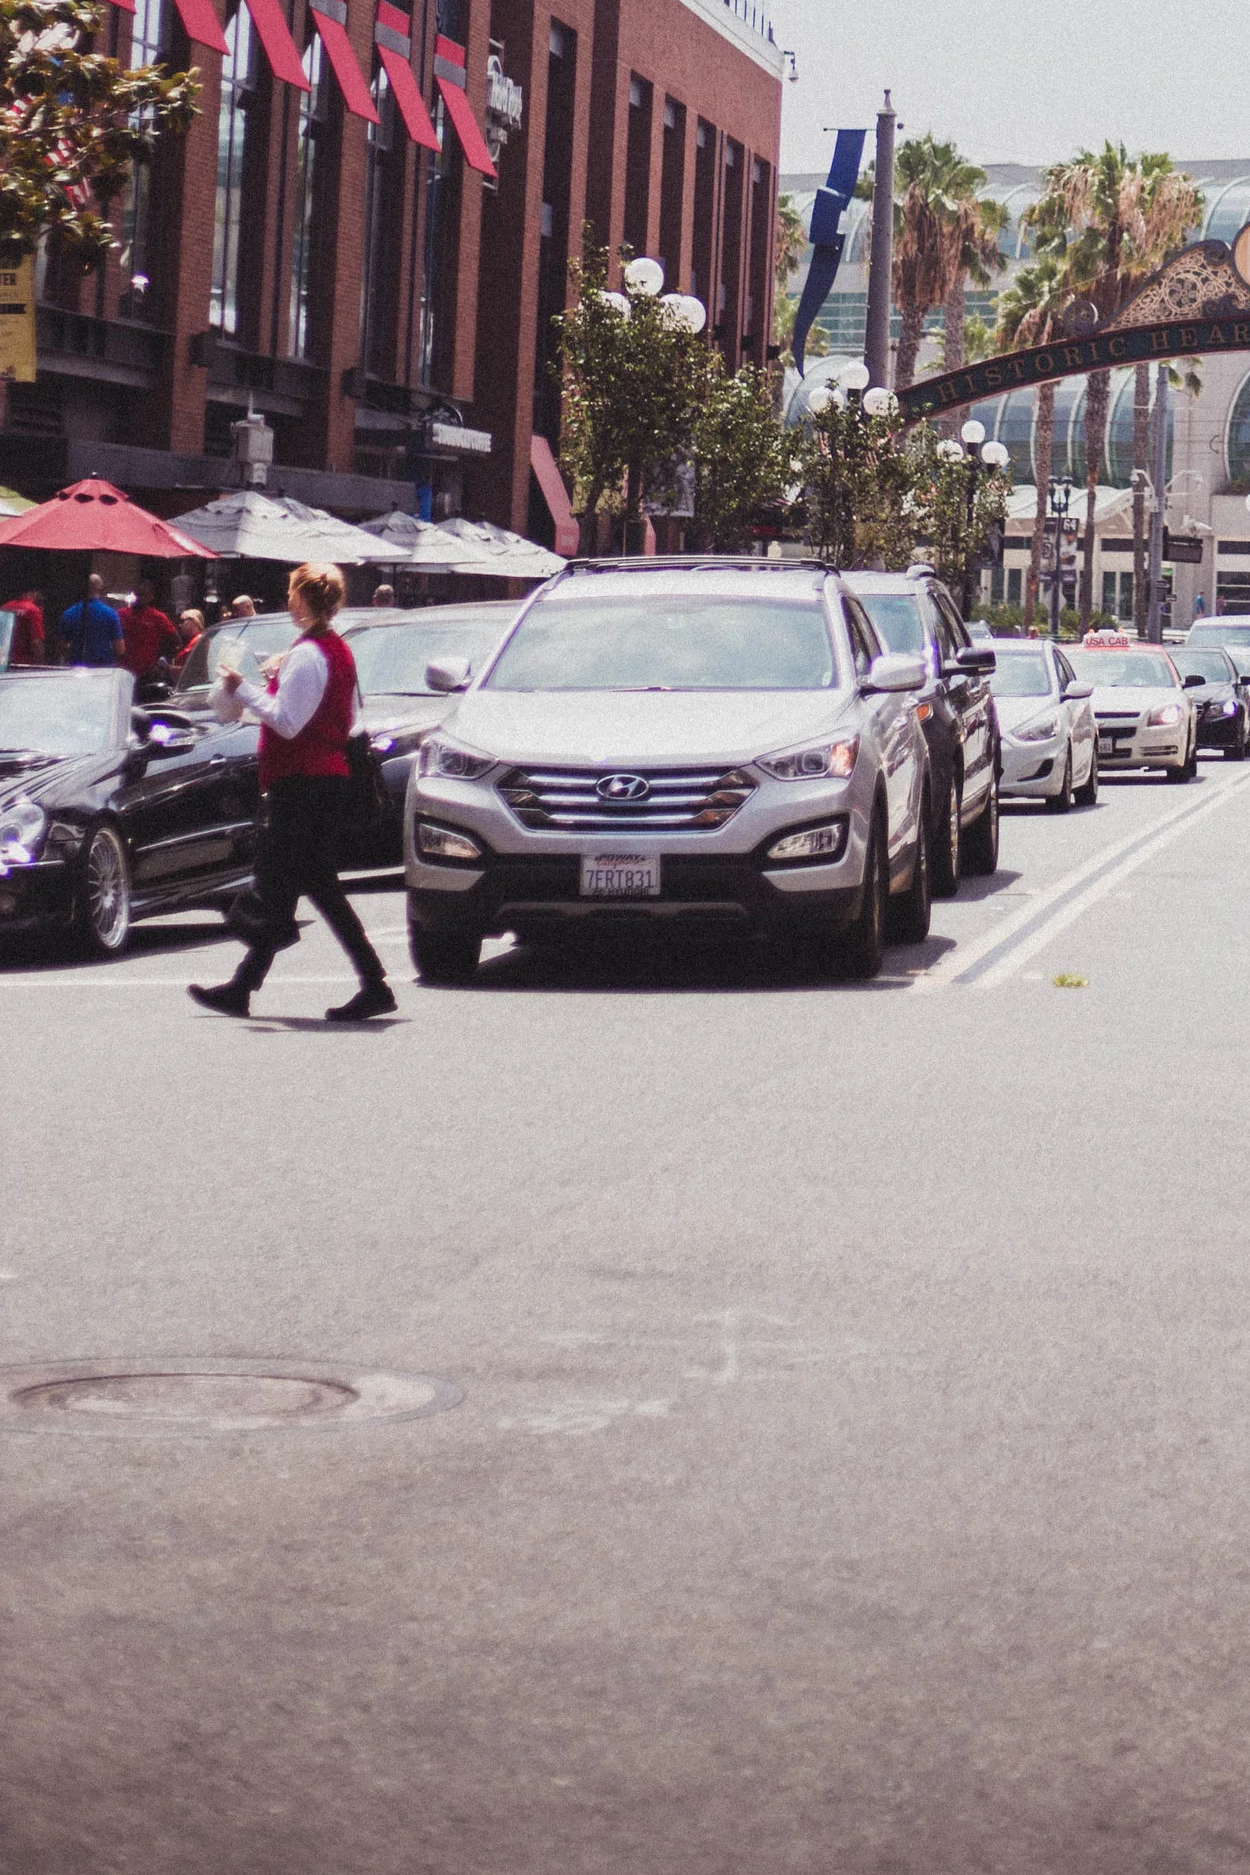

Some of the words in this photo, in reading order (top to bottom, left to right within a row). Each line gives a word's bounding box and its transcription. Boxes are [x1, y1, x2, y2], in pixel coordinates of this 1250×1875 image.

[936, 337, 1127, 403] HISTORIC
[1085, 636, 1105, 646] USA
[1108, 636, 1128, 646] CAB
[586, 869, 653, 889] 7FRT831
